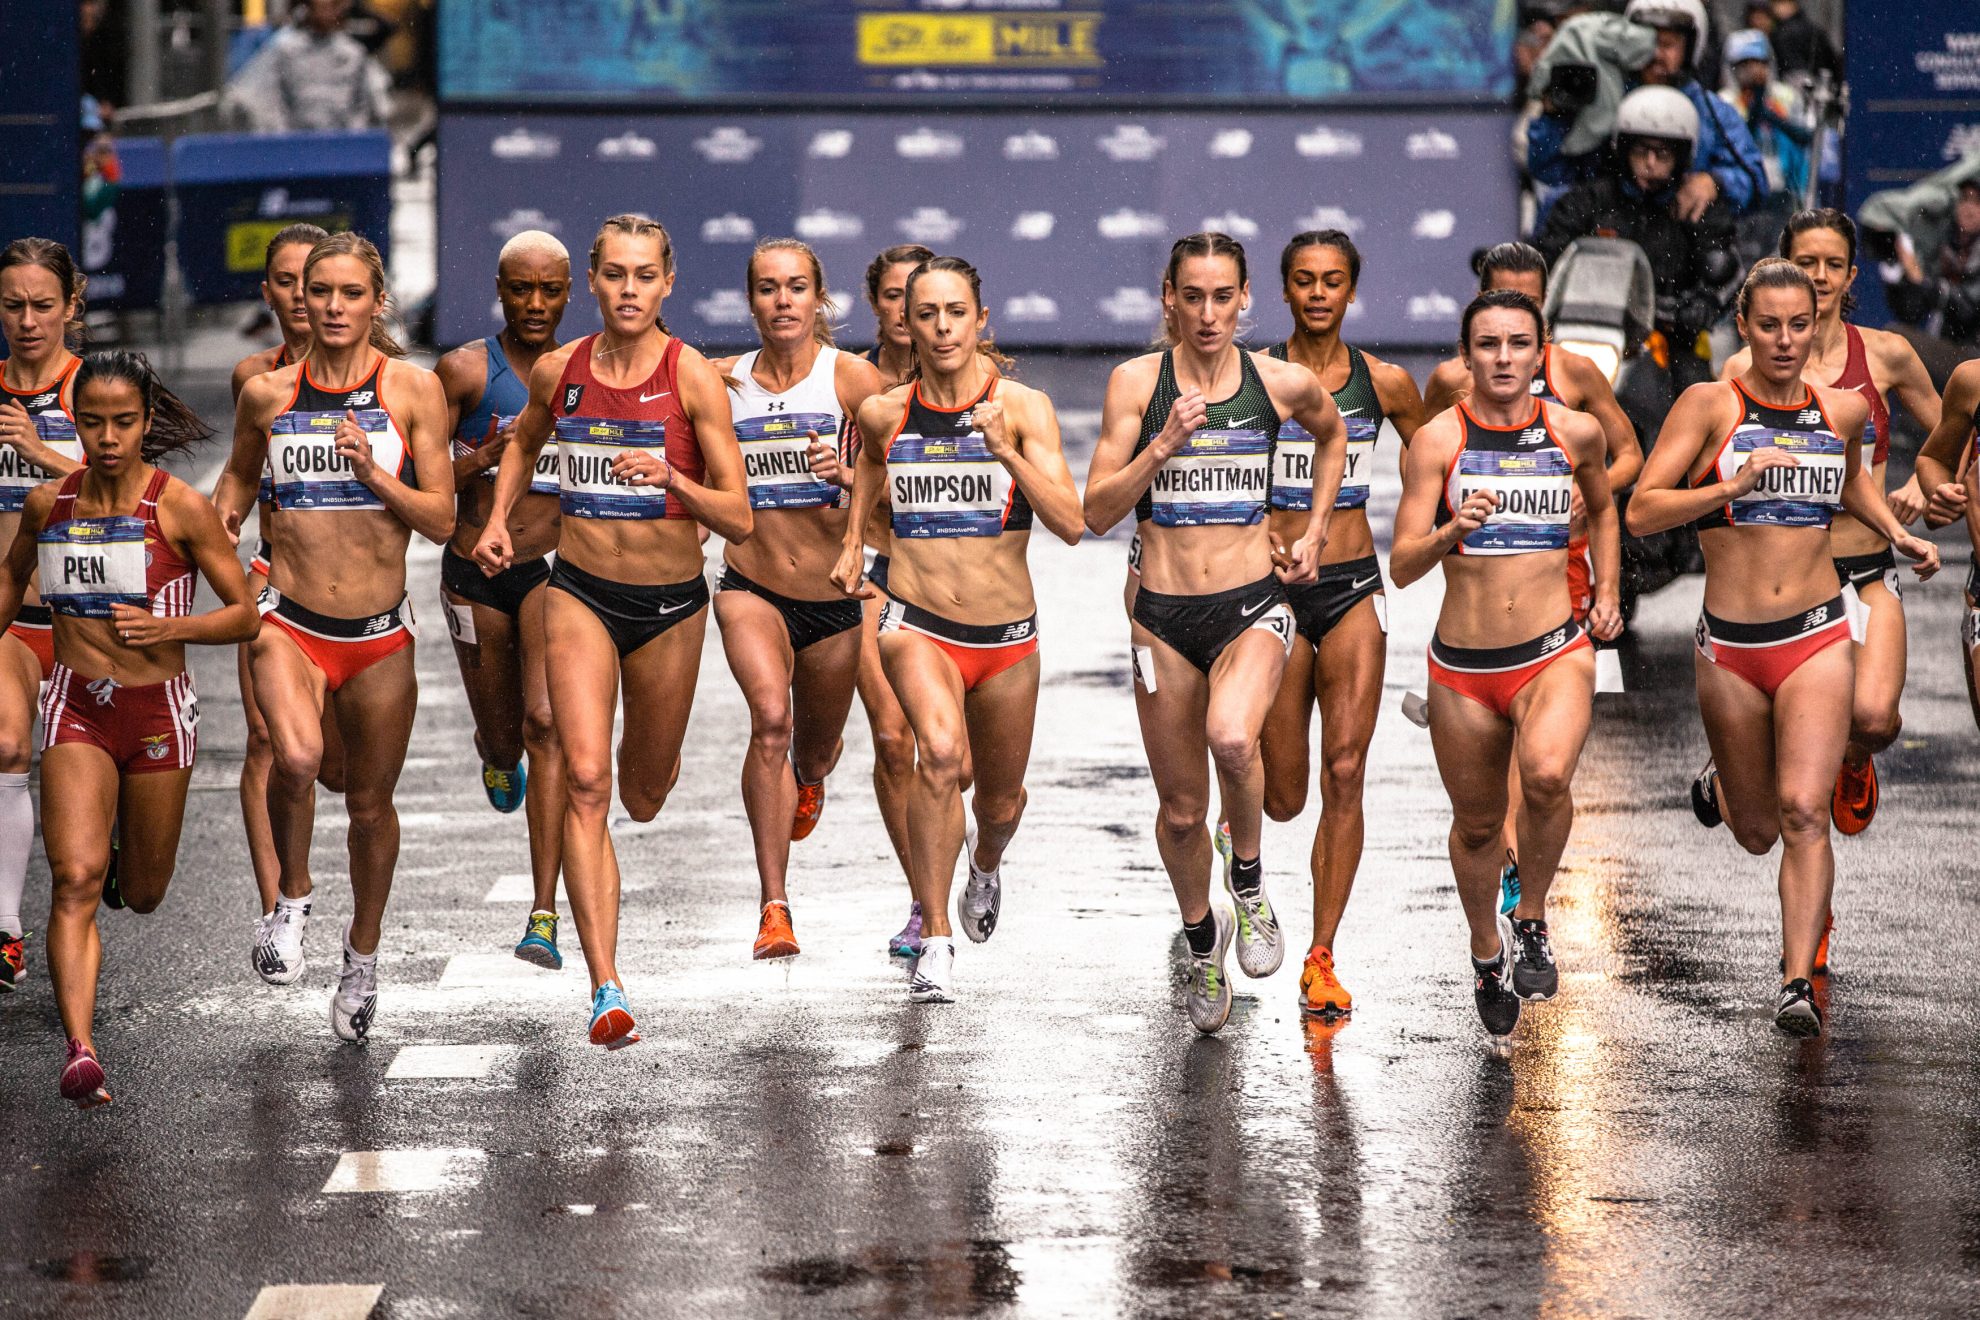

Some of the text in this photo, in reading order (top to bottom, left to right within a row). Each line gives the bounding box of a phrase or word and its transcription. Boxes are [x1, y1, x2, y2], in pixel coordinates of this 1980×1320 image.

[283, 445, 373, 474] COBU
[1281, 453, 1360, 479] TRY
[895, 474, 992, 504] SIMPSON
[1154, 467, 1266, 492] WEIGHTMAN
[1736, 464, 1844, 495] OURTNEY
[1461, 488, 1571, 515] DONALD
[936, 526, 979, 534] #NB5thAveMile
[63, 555, 106, 585] PEN
